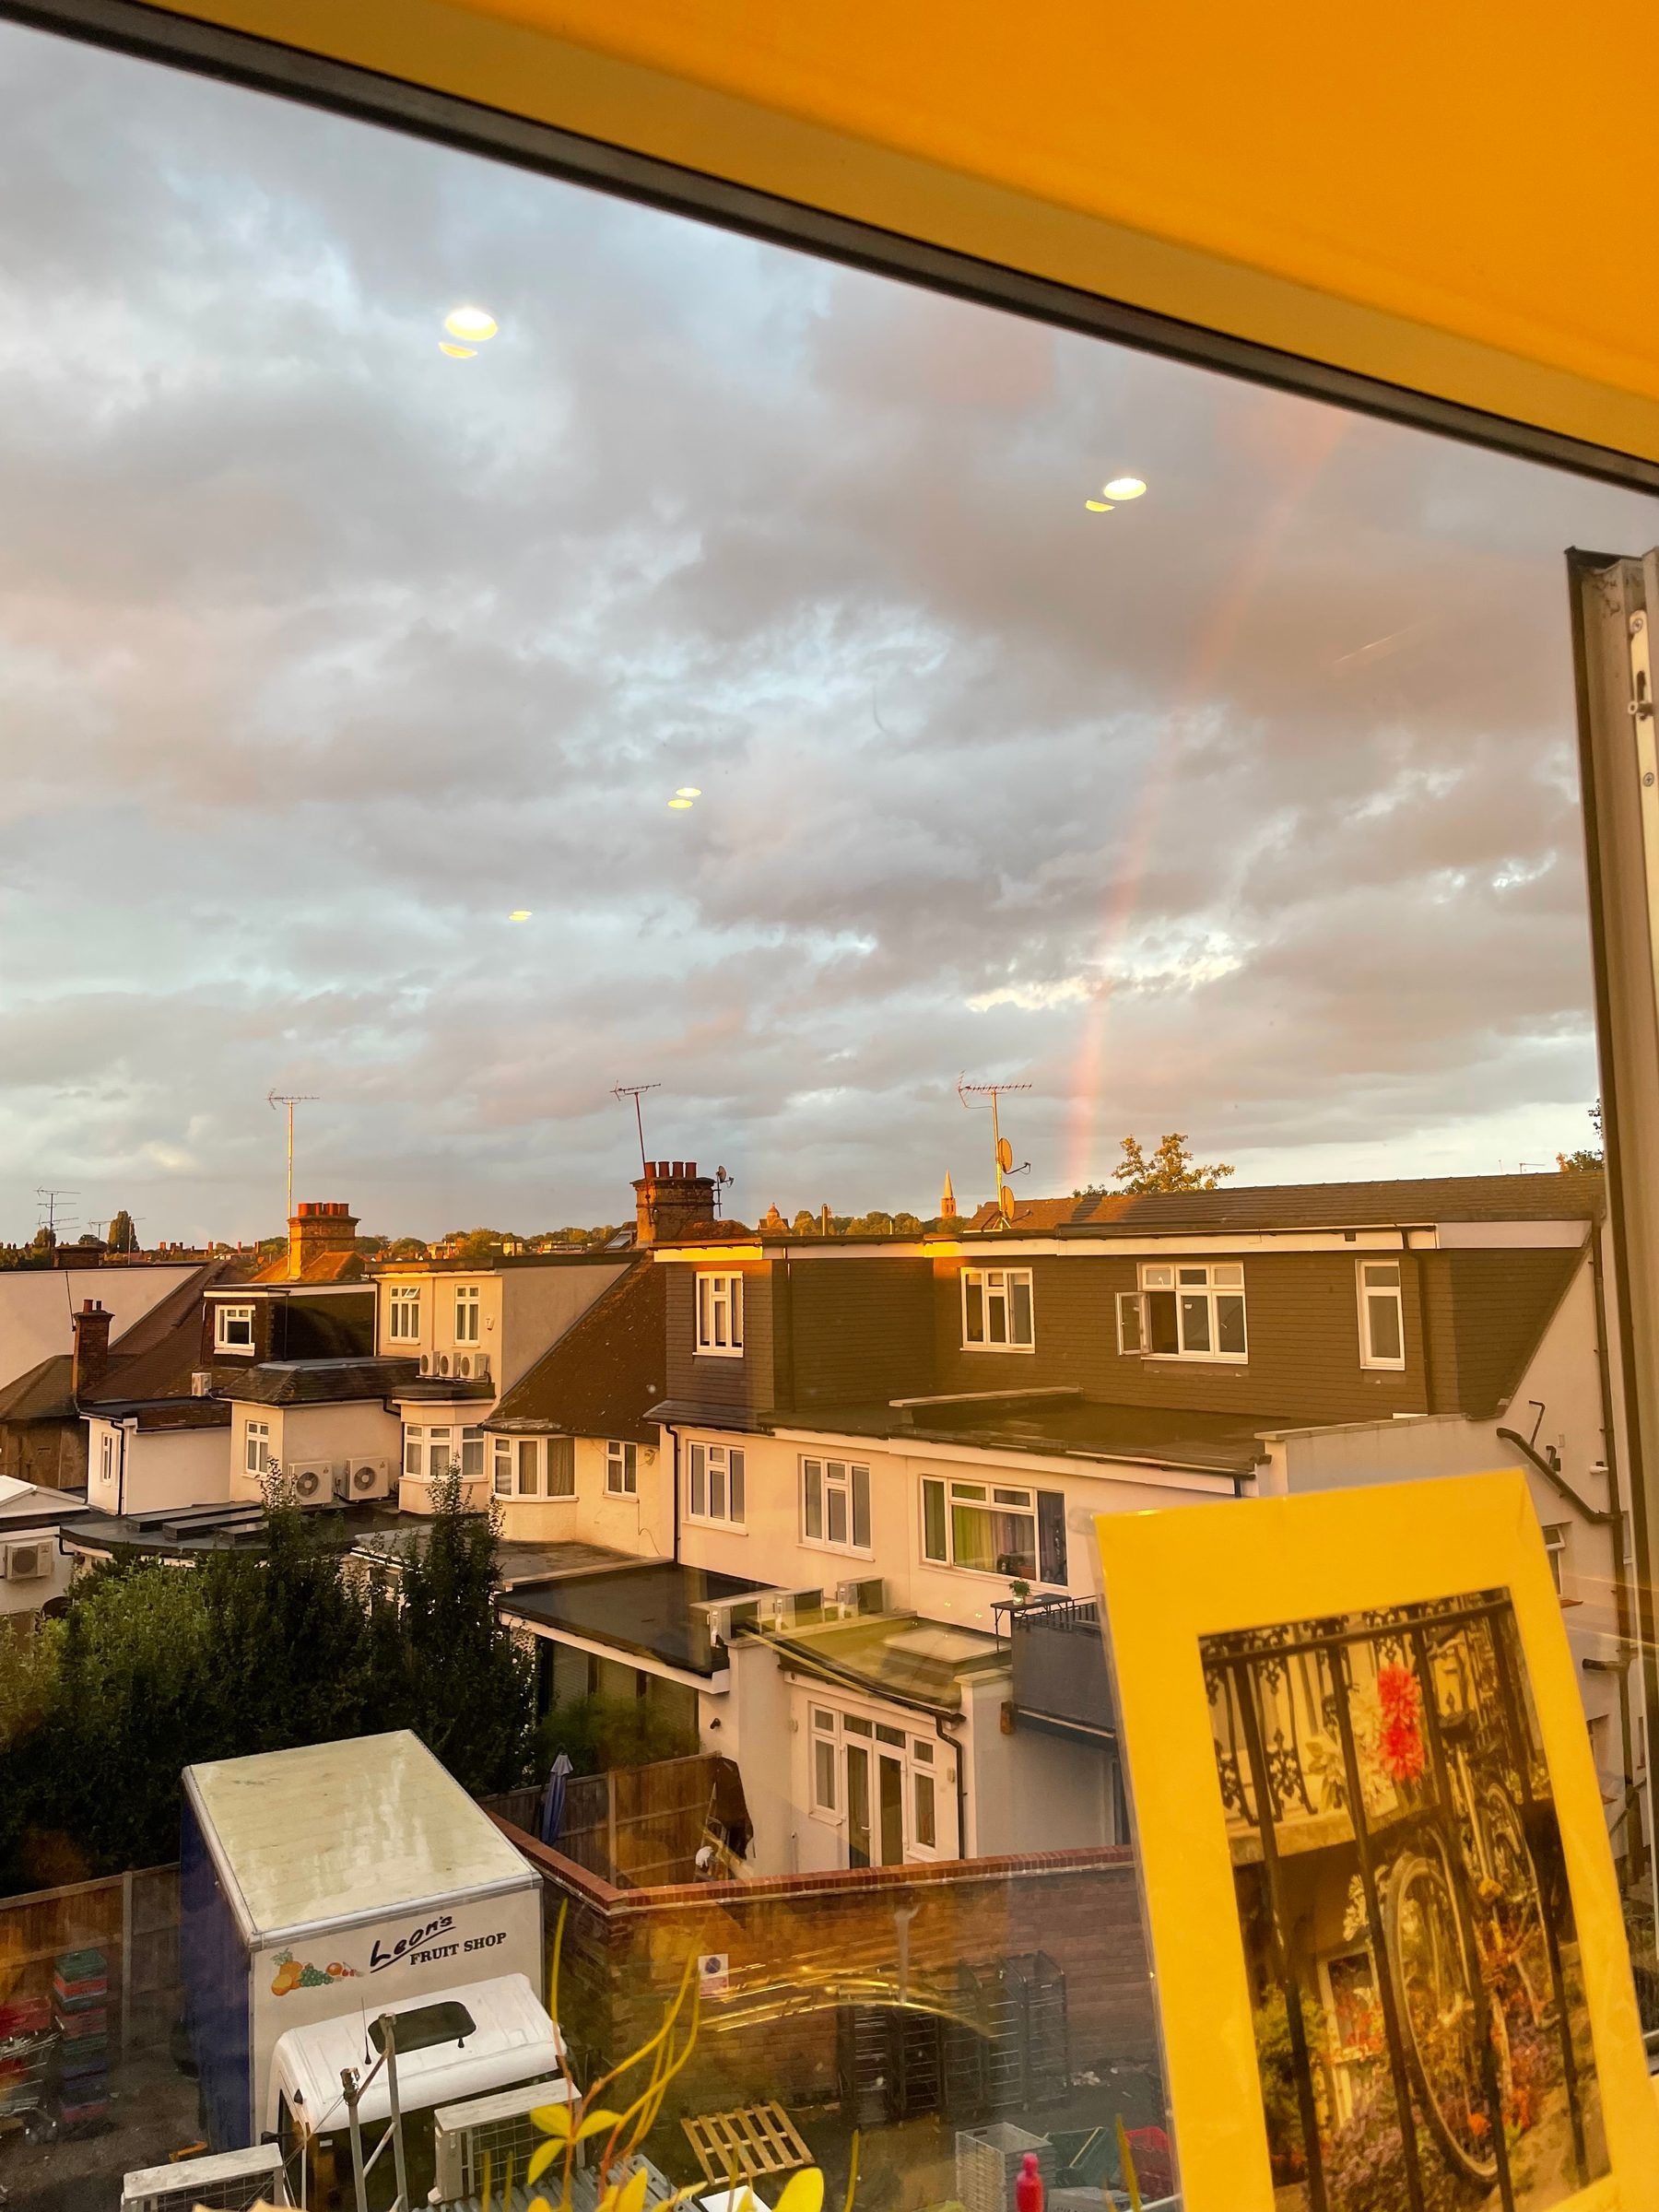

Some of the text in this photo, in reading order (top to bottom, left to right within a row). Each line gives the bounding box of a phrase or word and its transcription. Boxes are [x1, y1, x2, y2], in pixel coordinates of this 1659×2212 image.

[370, 1915, 453, 1967] Leon's
[409, 1932, 507, 1966] FRUIT SHOP
